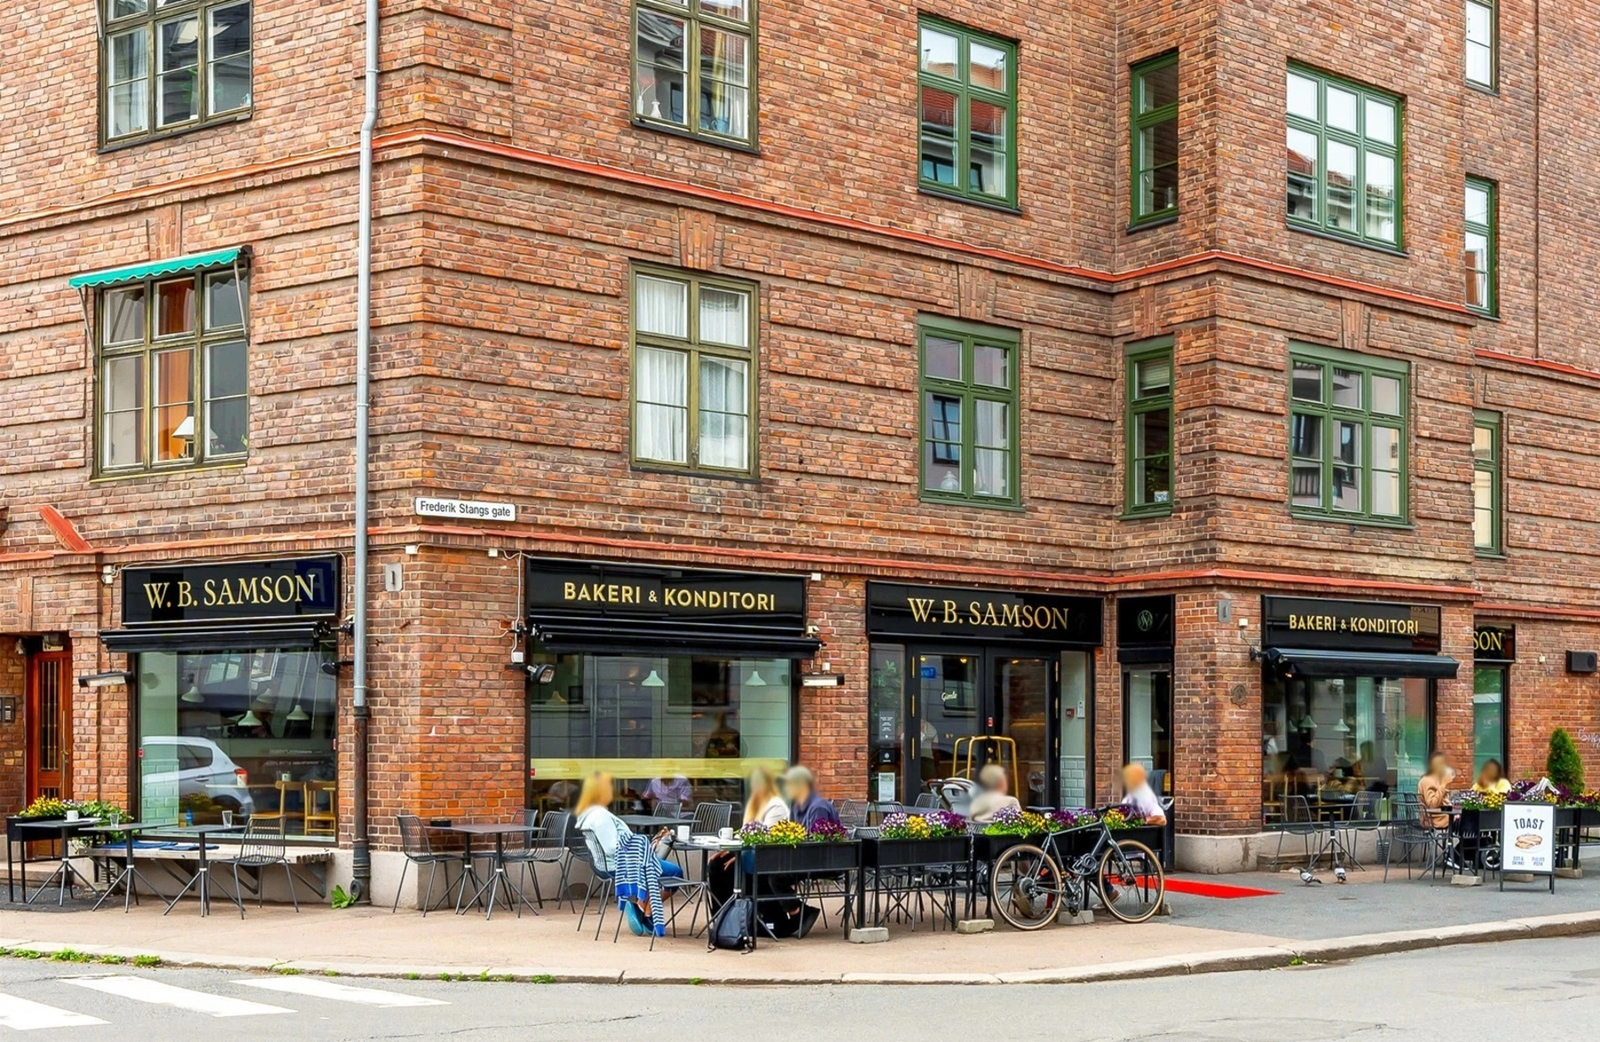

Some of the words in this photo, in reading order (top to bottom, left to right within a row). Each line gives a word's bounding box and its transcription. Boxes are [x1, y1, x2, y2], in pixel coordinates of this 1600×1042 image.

[420, 500, 456, 513] Frederik
[459, 503, 489, 517] Stangs
[491, 507, 511, 518] gate
[143, 582, 171, 609] W.
[177, 581, 198, 607] B.
[203, 574, 316, 606] SAMSON
[564, 582, 641, 604] BAKERI
[648, 590, 658, 603] &
[664, 587, 775, 611] KONDITORI
[907, 597, 937, 623] W.
[943, 599, 964, 624] B.
[969, 601, 1069, 630] SAMSON
[1289, 614, 1336, 631] BAKERI
[1340, 619, 1347, 630] &
[1350, 617, 1419, 634] KONDITORI
[1513, 817, 1545, 830] TOAST
